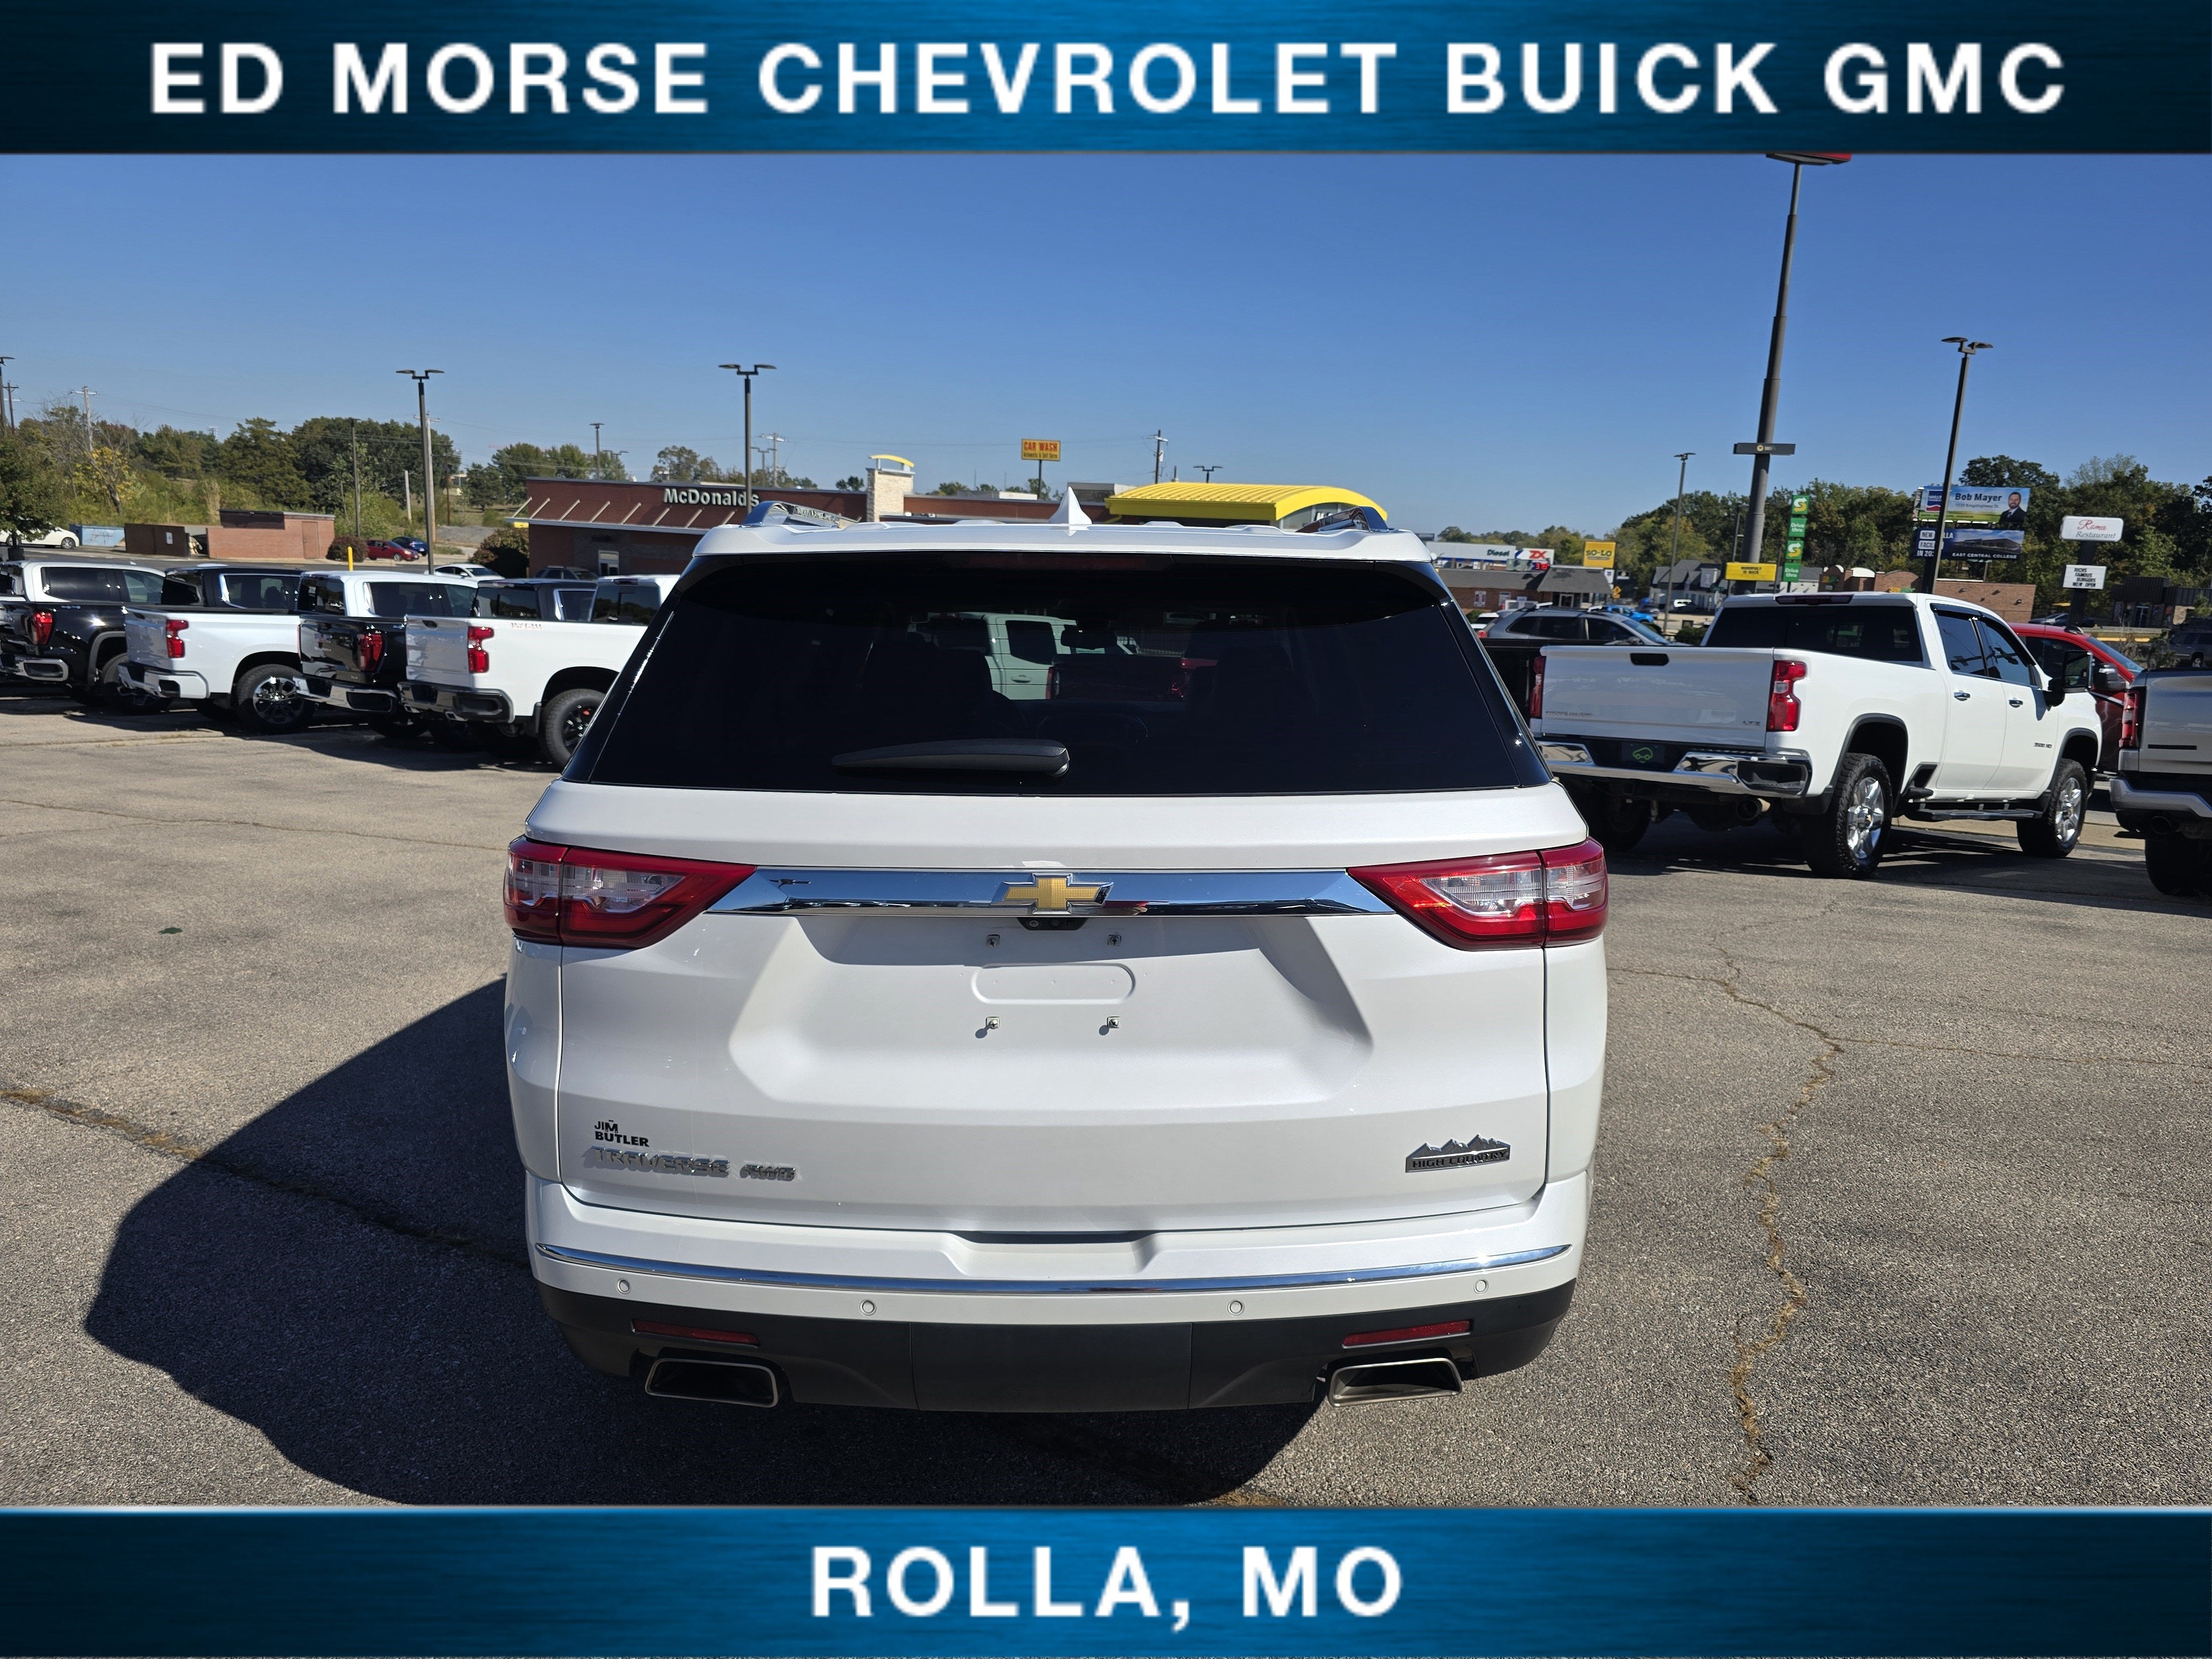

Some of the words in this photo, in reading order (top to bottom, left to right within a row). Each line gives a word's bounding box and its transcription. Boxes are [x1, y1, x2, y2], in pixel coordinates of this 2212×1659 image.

[1024, 441, 1036, 451] CAR
[1039, 442, 1058, 452] WASH
[1974, 493, 2002, 503] Mayer
[594, 1120, 618, 1133] JIM
[594, 1131, 649, 1147] BUTLER
[591, 1146, 731, 1177] TRAVERSE
[1413, 1159, 1444, 1168] HIGH
[1449, 1151, 1508, 1165] COUNTRY
